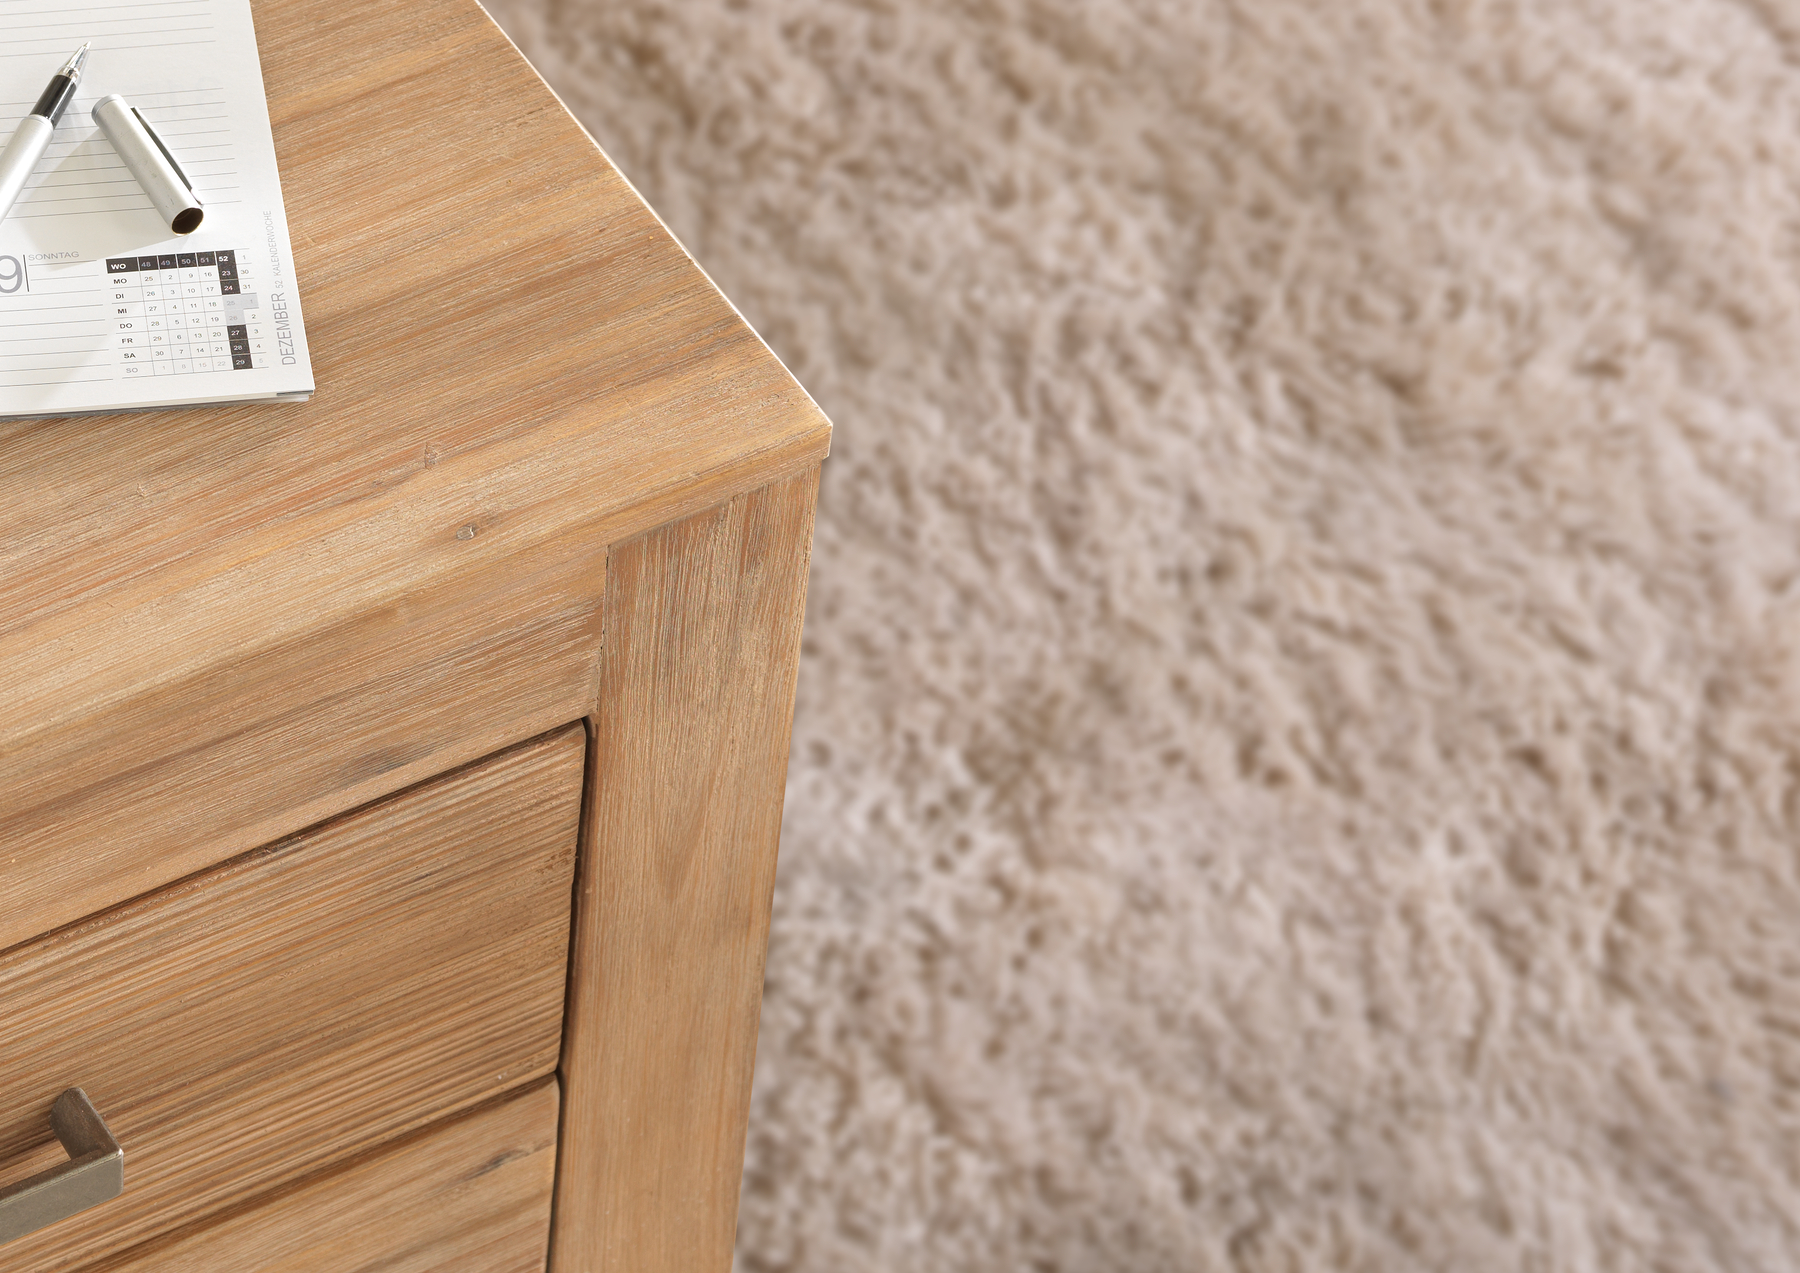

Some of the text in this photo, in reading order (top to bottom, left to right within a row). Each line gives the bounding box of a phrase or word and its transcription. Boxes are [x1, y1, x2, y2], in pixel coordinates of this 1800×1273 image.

[28, 250, 80, 261] SONNTAG
[263, 210, 282, 276] KALENDERWOCHE
[271, 292, 296, 365] DEZEMBER
